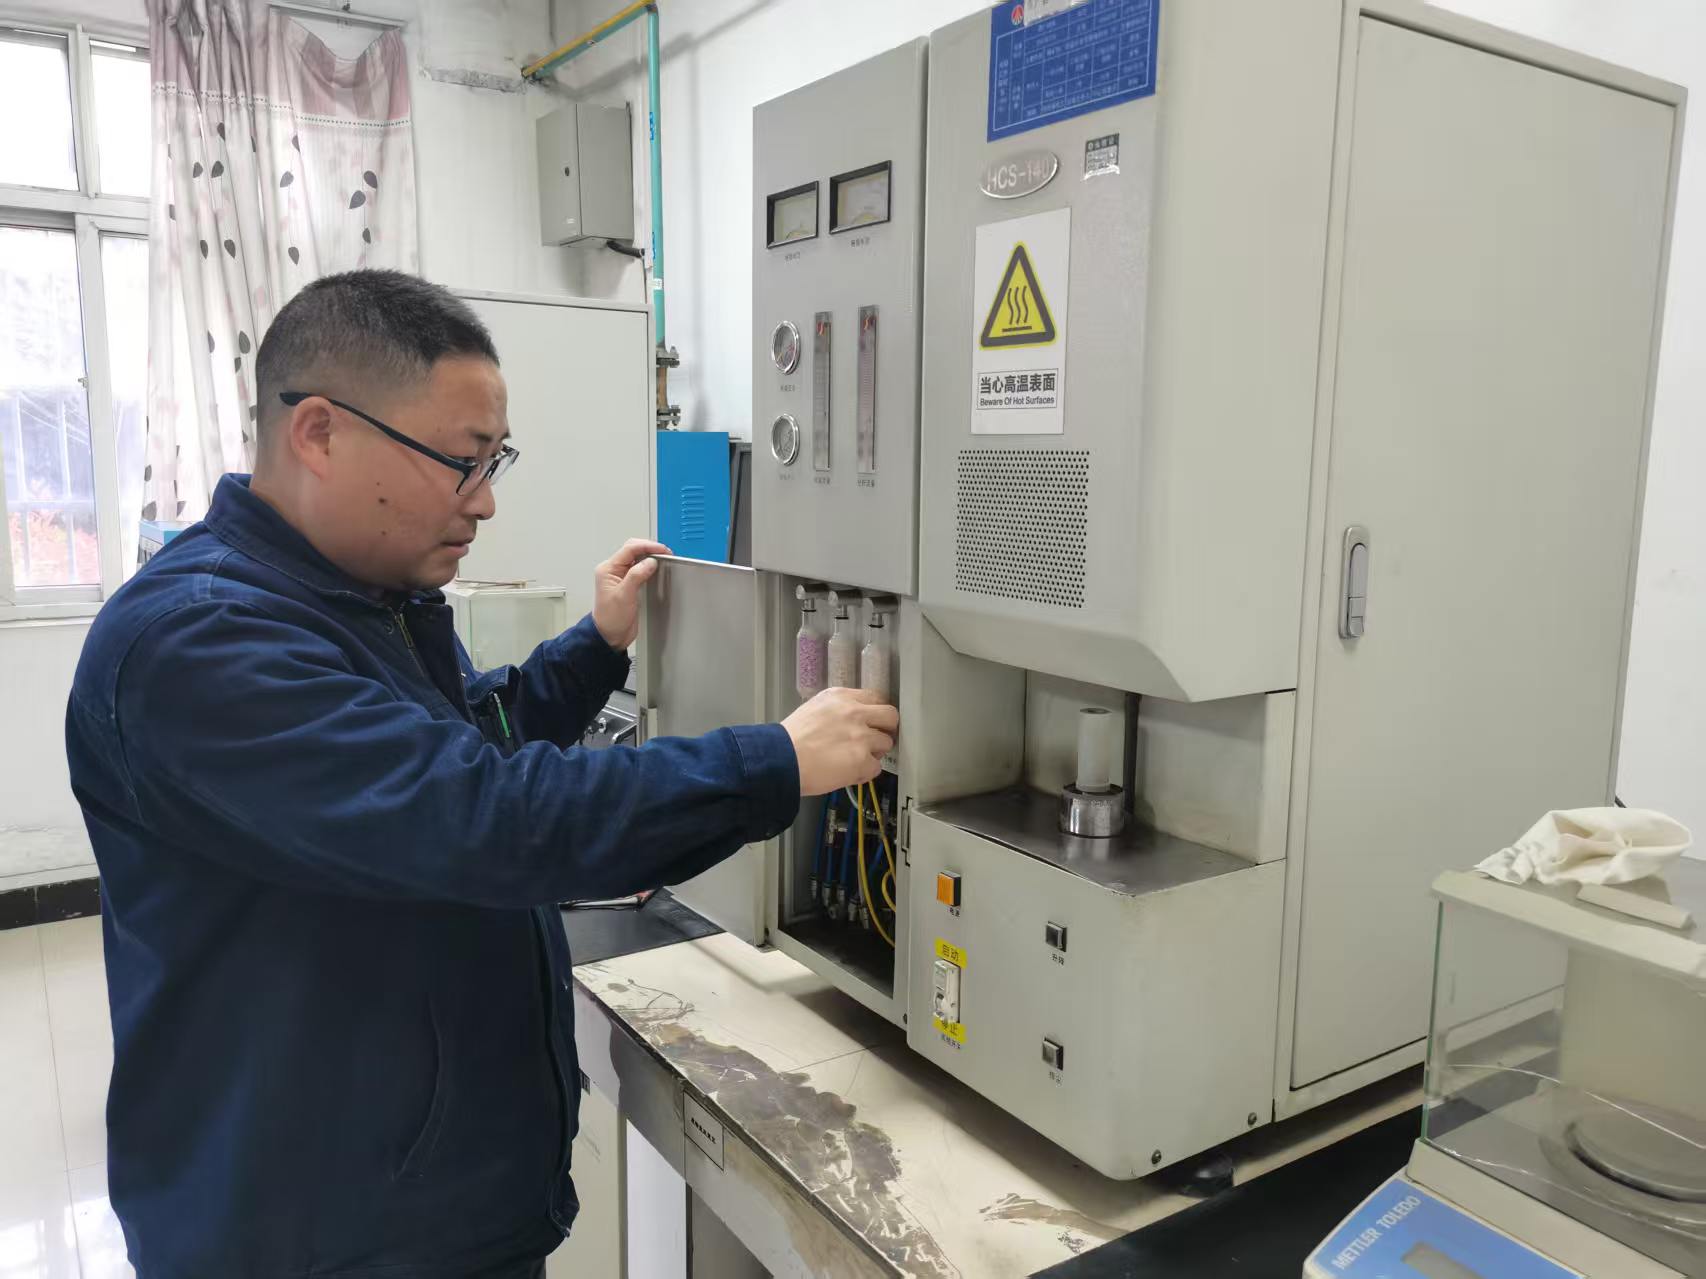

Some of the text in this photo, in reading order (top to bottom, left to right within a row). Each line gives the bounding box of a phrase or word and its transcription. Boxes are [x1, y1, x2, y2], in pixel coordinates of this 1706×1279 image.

[980, 373, 1056, 394] 当心高温表面
[980, 396, 1055, 406] Beware Of Hot Surfaces
[1331, 1195, 1422, 1270] METTLER TOLEDO
